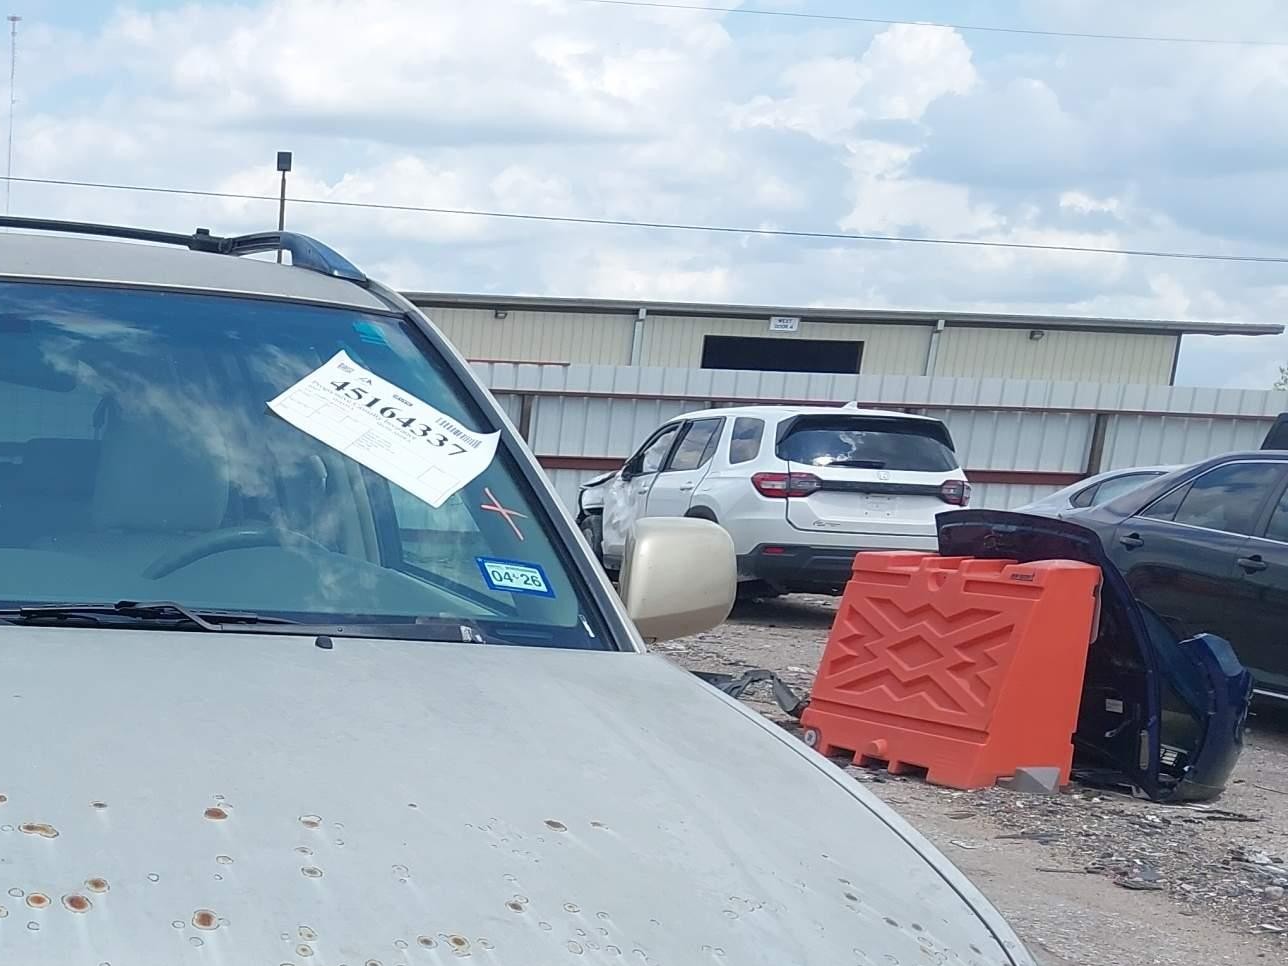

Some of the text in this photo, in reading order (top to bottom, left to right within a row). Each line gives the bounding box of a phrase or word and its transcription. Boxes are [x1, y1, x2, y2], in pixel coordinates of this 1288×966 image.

[330, 381, 468, 456] 45164337
[492, 570, 542, 587] 04 26
